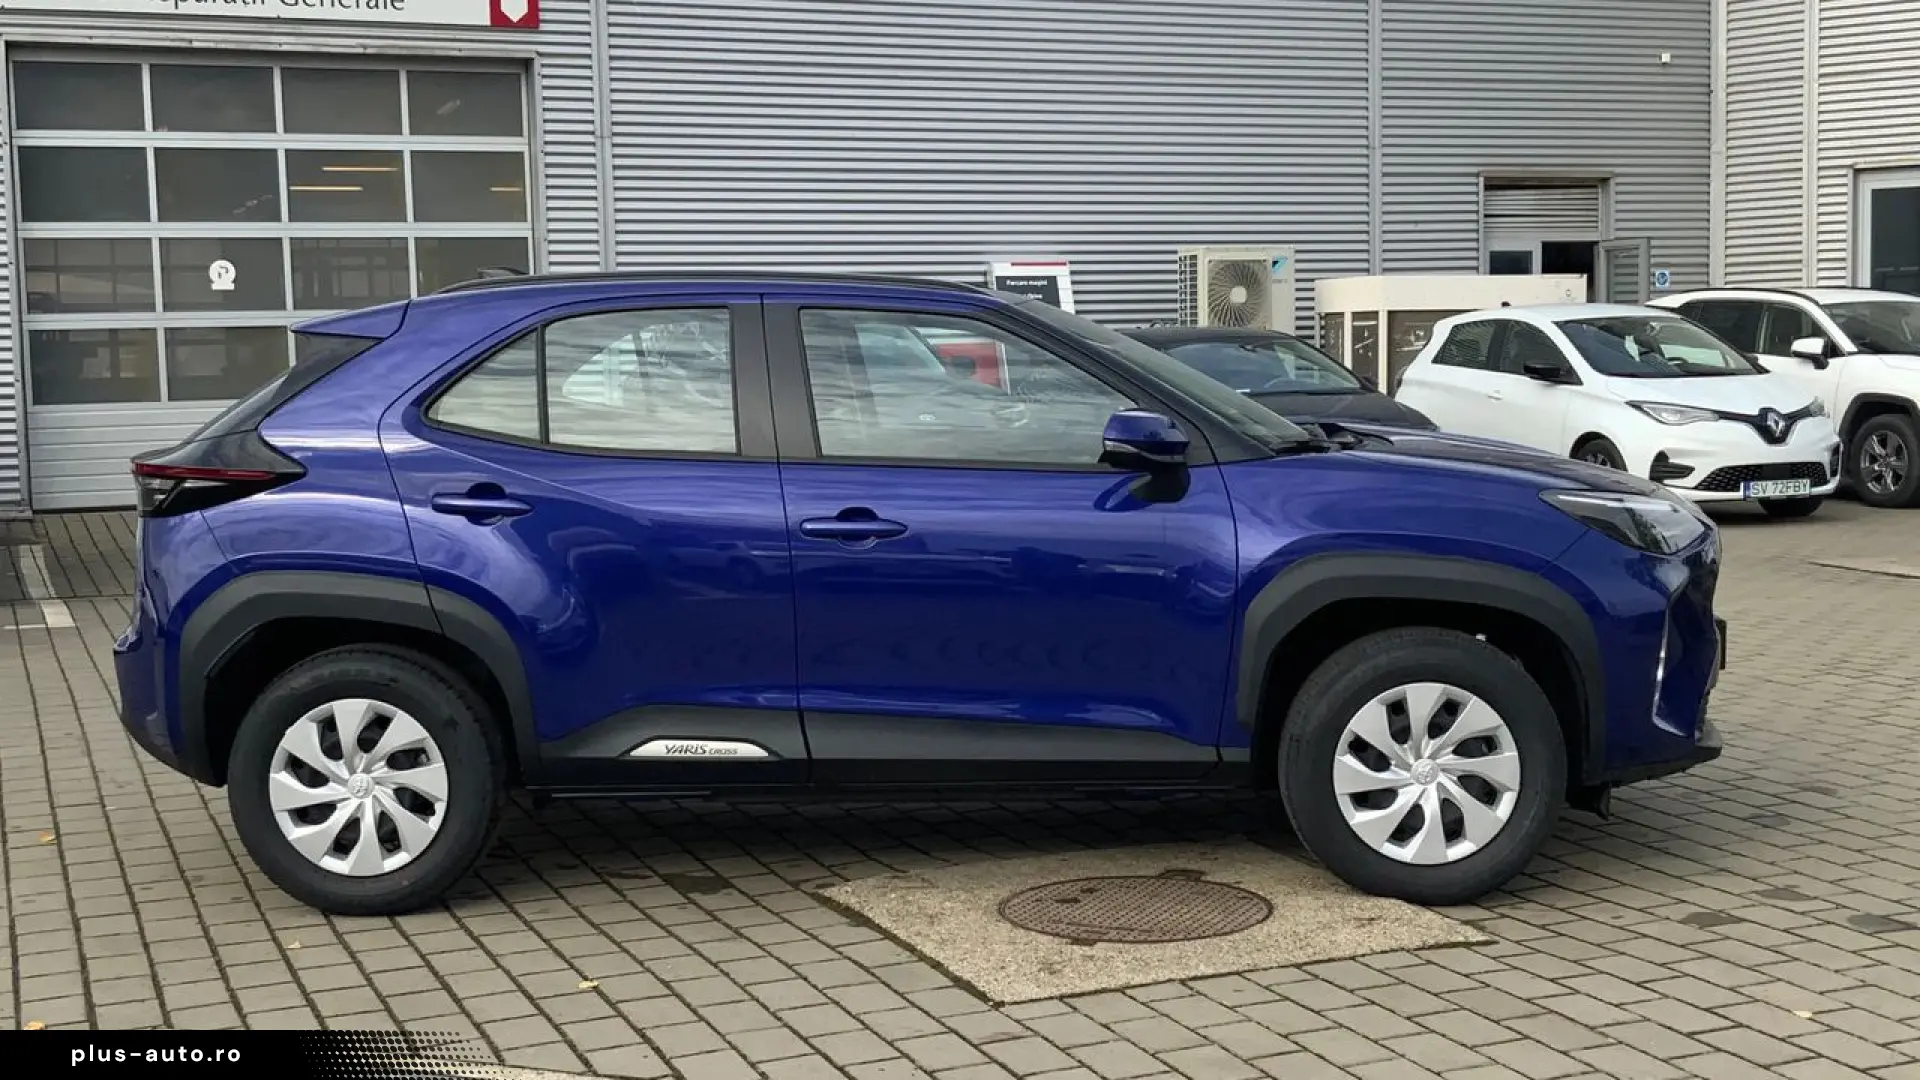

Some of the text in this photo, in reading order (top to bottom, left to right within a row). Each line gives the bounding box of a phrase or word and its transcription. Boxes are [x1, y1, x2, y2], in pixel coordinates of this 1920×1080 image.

[1751, 480, 1808, 496] SV 72FBY
[664, 744, 739, 756] YARIS CROSS
